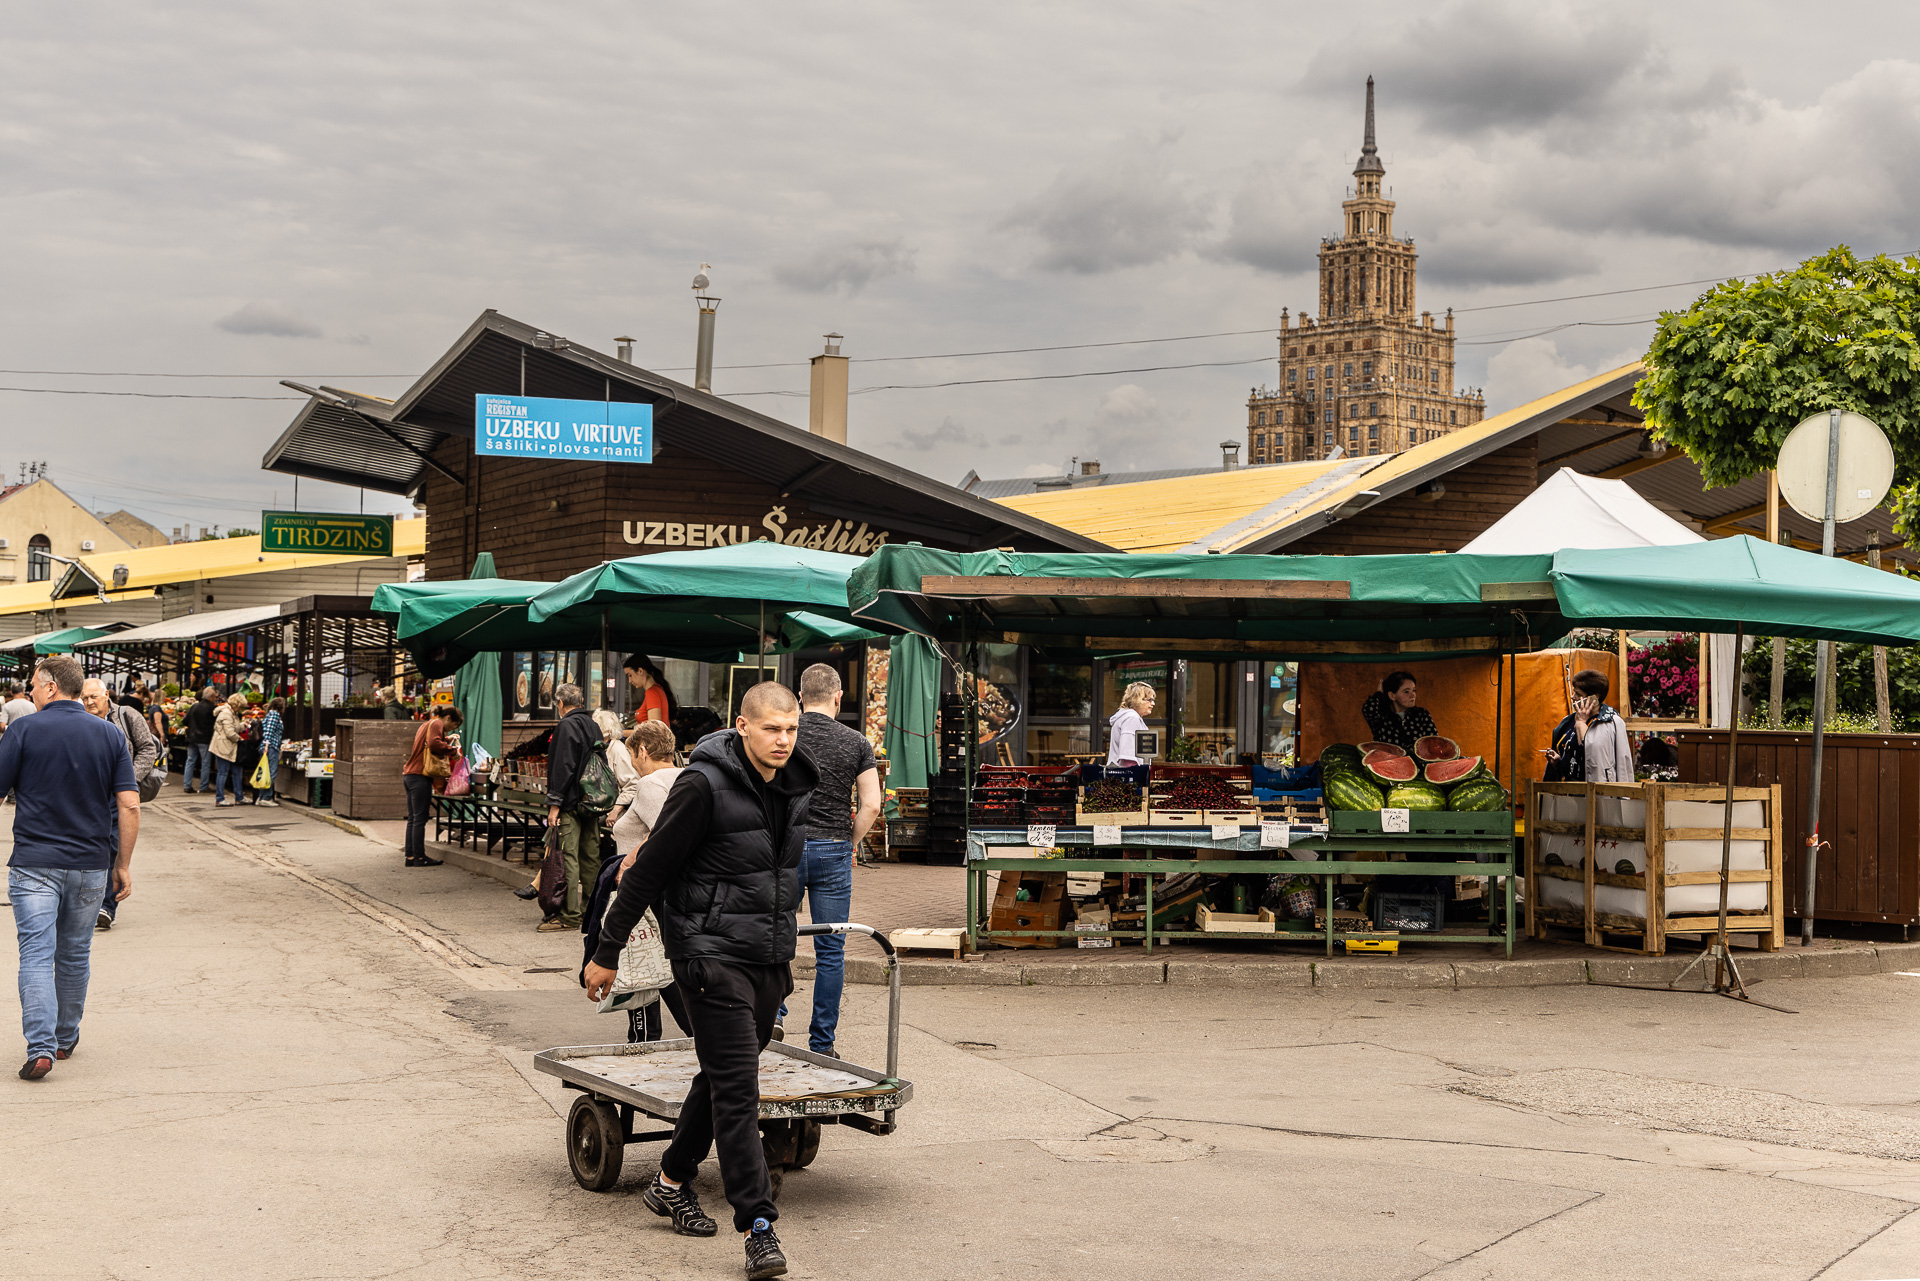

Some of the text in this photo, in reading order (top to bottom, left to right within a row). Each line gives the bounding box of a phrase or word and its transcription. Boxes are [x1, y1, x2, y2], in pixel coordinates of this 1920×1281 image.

[486, 404, 528, 417] REGISTAN
[486, 418, 643, 445] UZBEKU VIRTUVE
[271, 525, 383, 551] TIRDZIŅŠ
[622, 505, 889, 553] UZBEKU Šašliks
